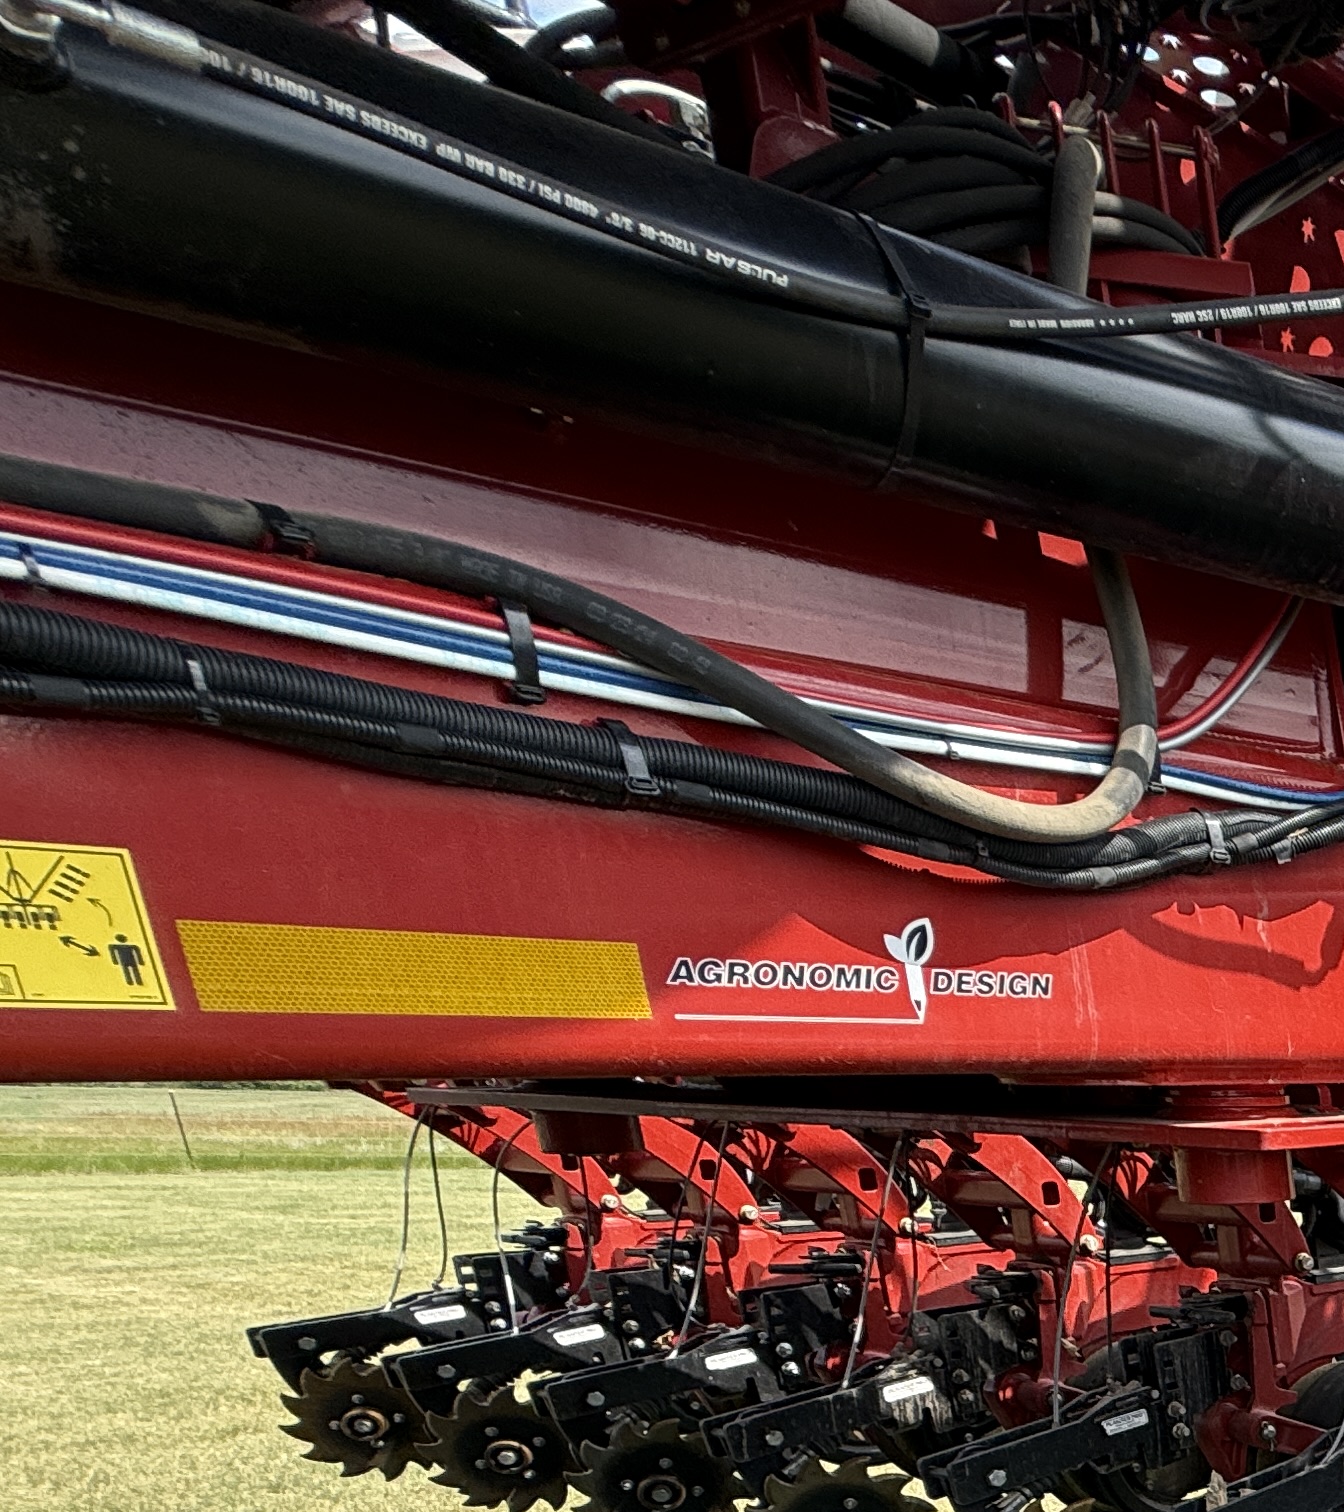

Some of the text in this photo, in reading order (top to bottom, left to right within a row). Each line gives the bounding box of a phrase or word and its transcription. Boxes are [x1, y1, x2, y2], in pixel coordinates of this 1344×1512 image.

[322, 94, 358, 123] SAE
[360, 110, 428, 151] EXCEEDS
[434, 142, 463, 164] WP
[463, 152, 496, 178] BAR
[497, 165, 527, 191] 330
[538, 183, 562, 205] PSI
[704, 247, 790, 288] PULSAR
[666, 957, 1053, 999] AGRONOMIC DESIGN
